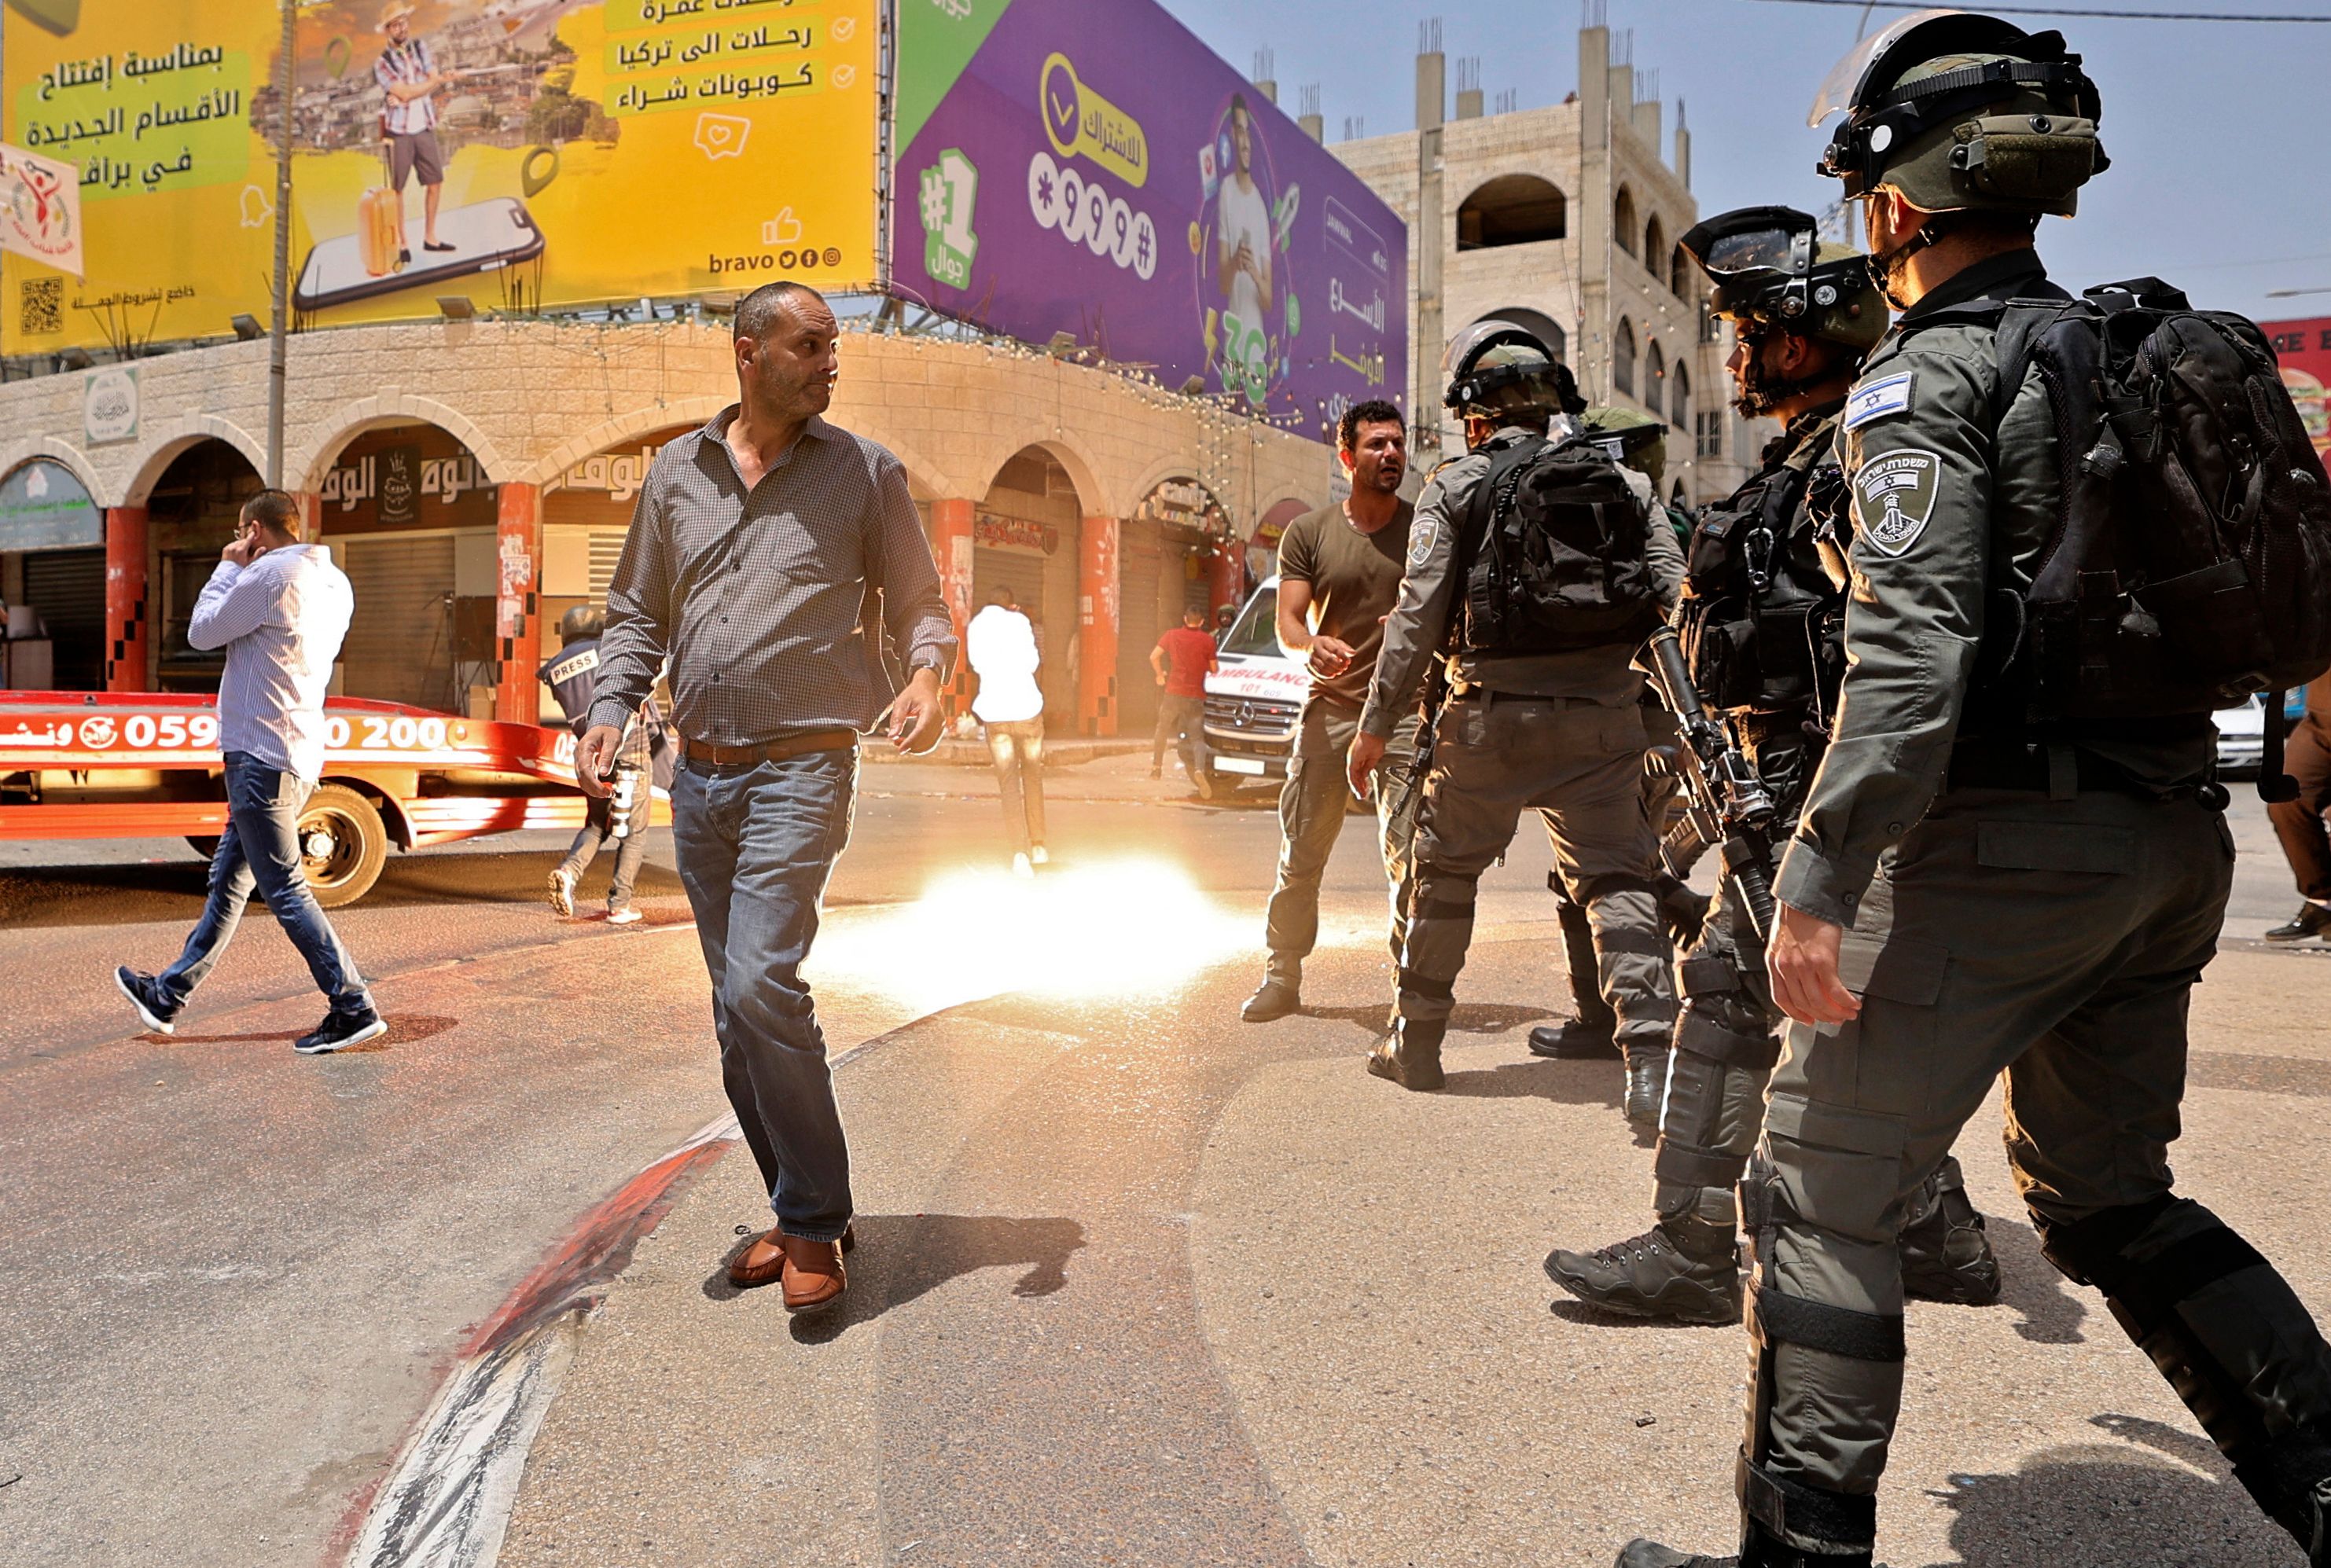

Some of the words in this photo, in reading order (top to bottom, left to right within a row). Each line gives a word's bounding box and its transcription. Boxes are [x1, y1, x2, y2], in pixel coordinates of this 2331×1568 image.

[617, 40, 671, 71] تركيا
[730, 26, 811, 50] رحلات
[39, 56, 112, 101] إفتتاح
[123, 43, 222, 84] بمناسبة
[698, 63, 813, 98] كوبونات
[617, 76, 687, 109] شراء
[26, 108, 123, 149] الجديدة
[133, 90, 240, 140] الأقسام
[1084, 111, 1140, 167] للاشتراك
[141, 147, 192, 192] في
[709, 254, 774, 274] bravo
[932, 244, 963, 284] جوال
[1222, 312, 1266, 403] 3G
[553, 655, 591, 679] PRESS
[1208, 668, 1308, 686] AMBULANC
[361, 718, 445, 747] 200
